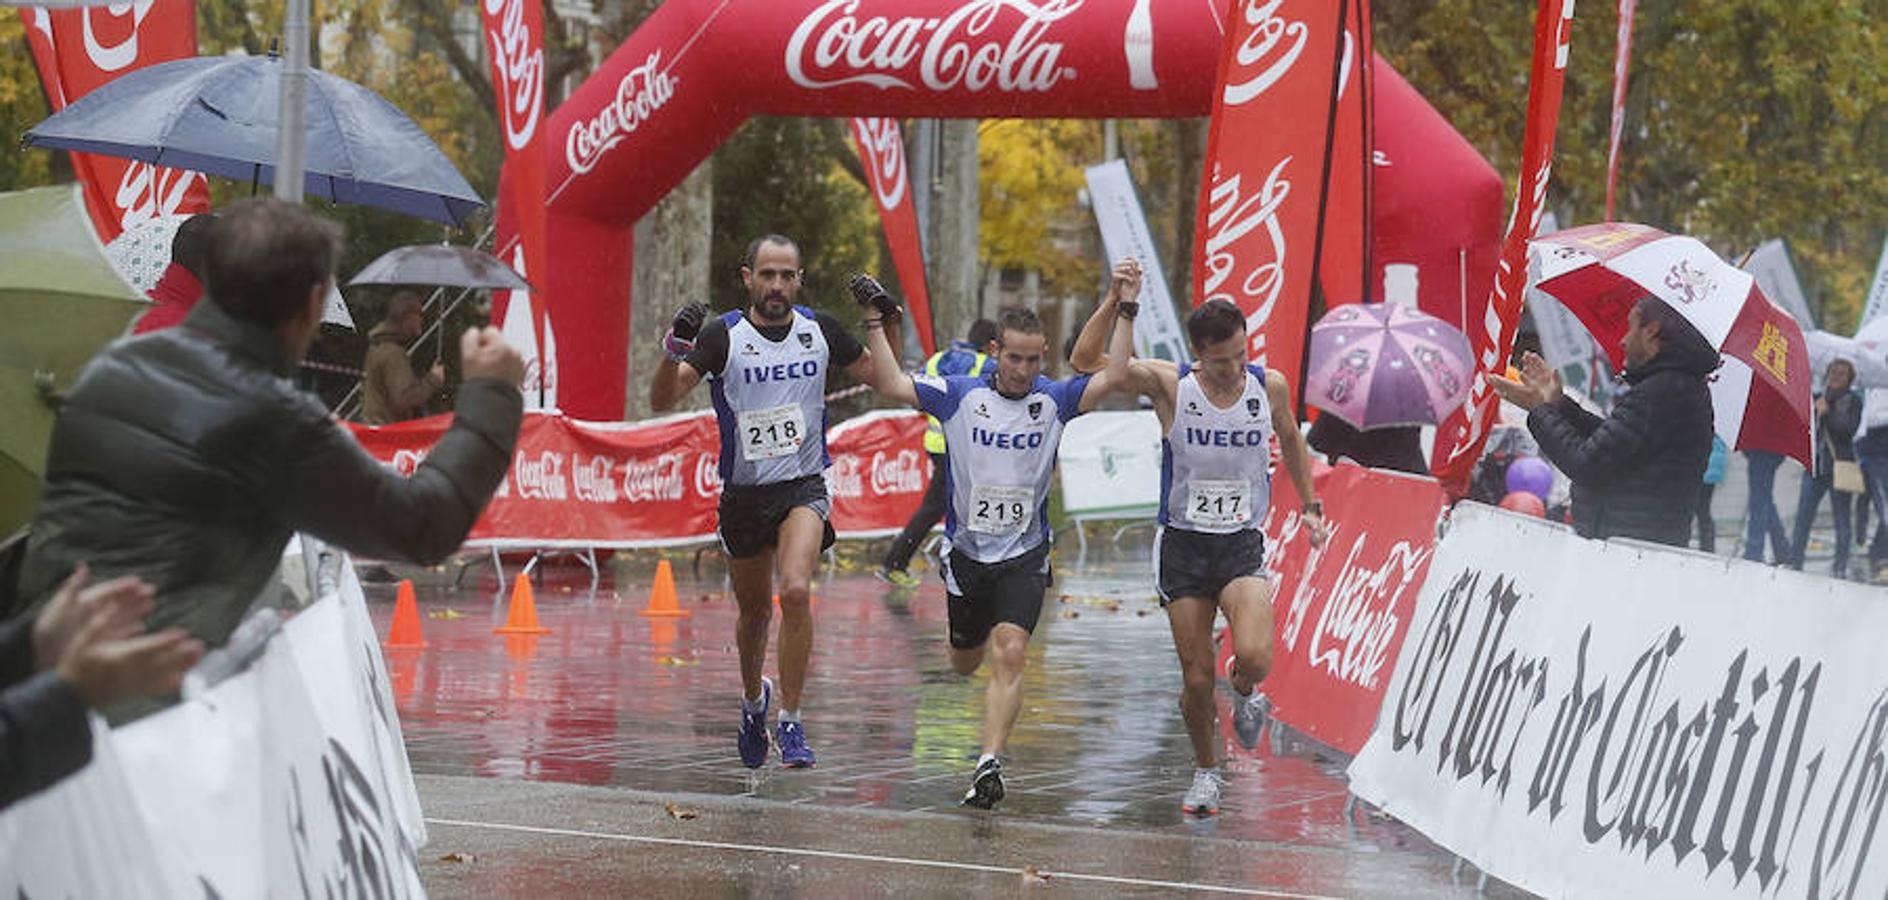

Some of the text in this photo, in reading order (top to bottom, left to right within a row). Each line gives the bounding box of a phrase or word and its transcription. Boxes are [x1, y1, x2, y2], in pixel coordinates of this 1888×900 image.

[785, 0, 1067, 91] Coca-Cola
[566, 49, 674, 174] Coca-Cola
[744, 360, 818, 384] IVECO
[748, 420, 798, 446] 218
[972, 427, 1043, 450] IVECO
[1186, 427, 1262, 448] IVECO
[515, 450, 567, 499] Coca-Cola
[573, 453, 617, 502] Coca-Cola
[871, 450, 922, 496] Coca-Cola
[976, 500, 1024, 521] 219
[1196, 495, 1242, 514] 217
[1310, 531, 1434, 690] Coca-Cola
